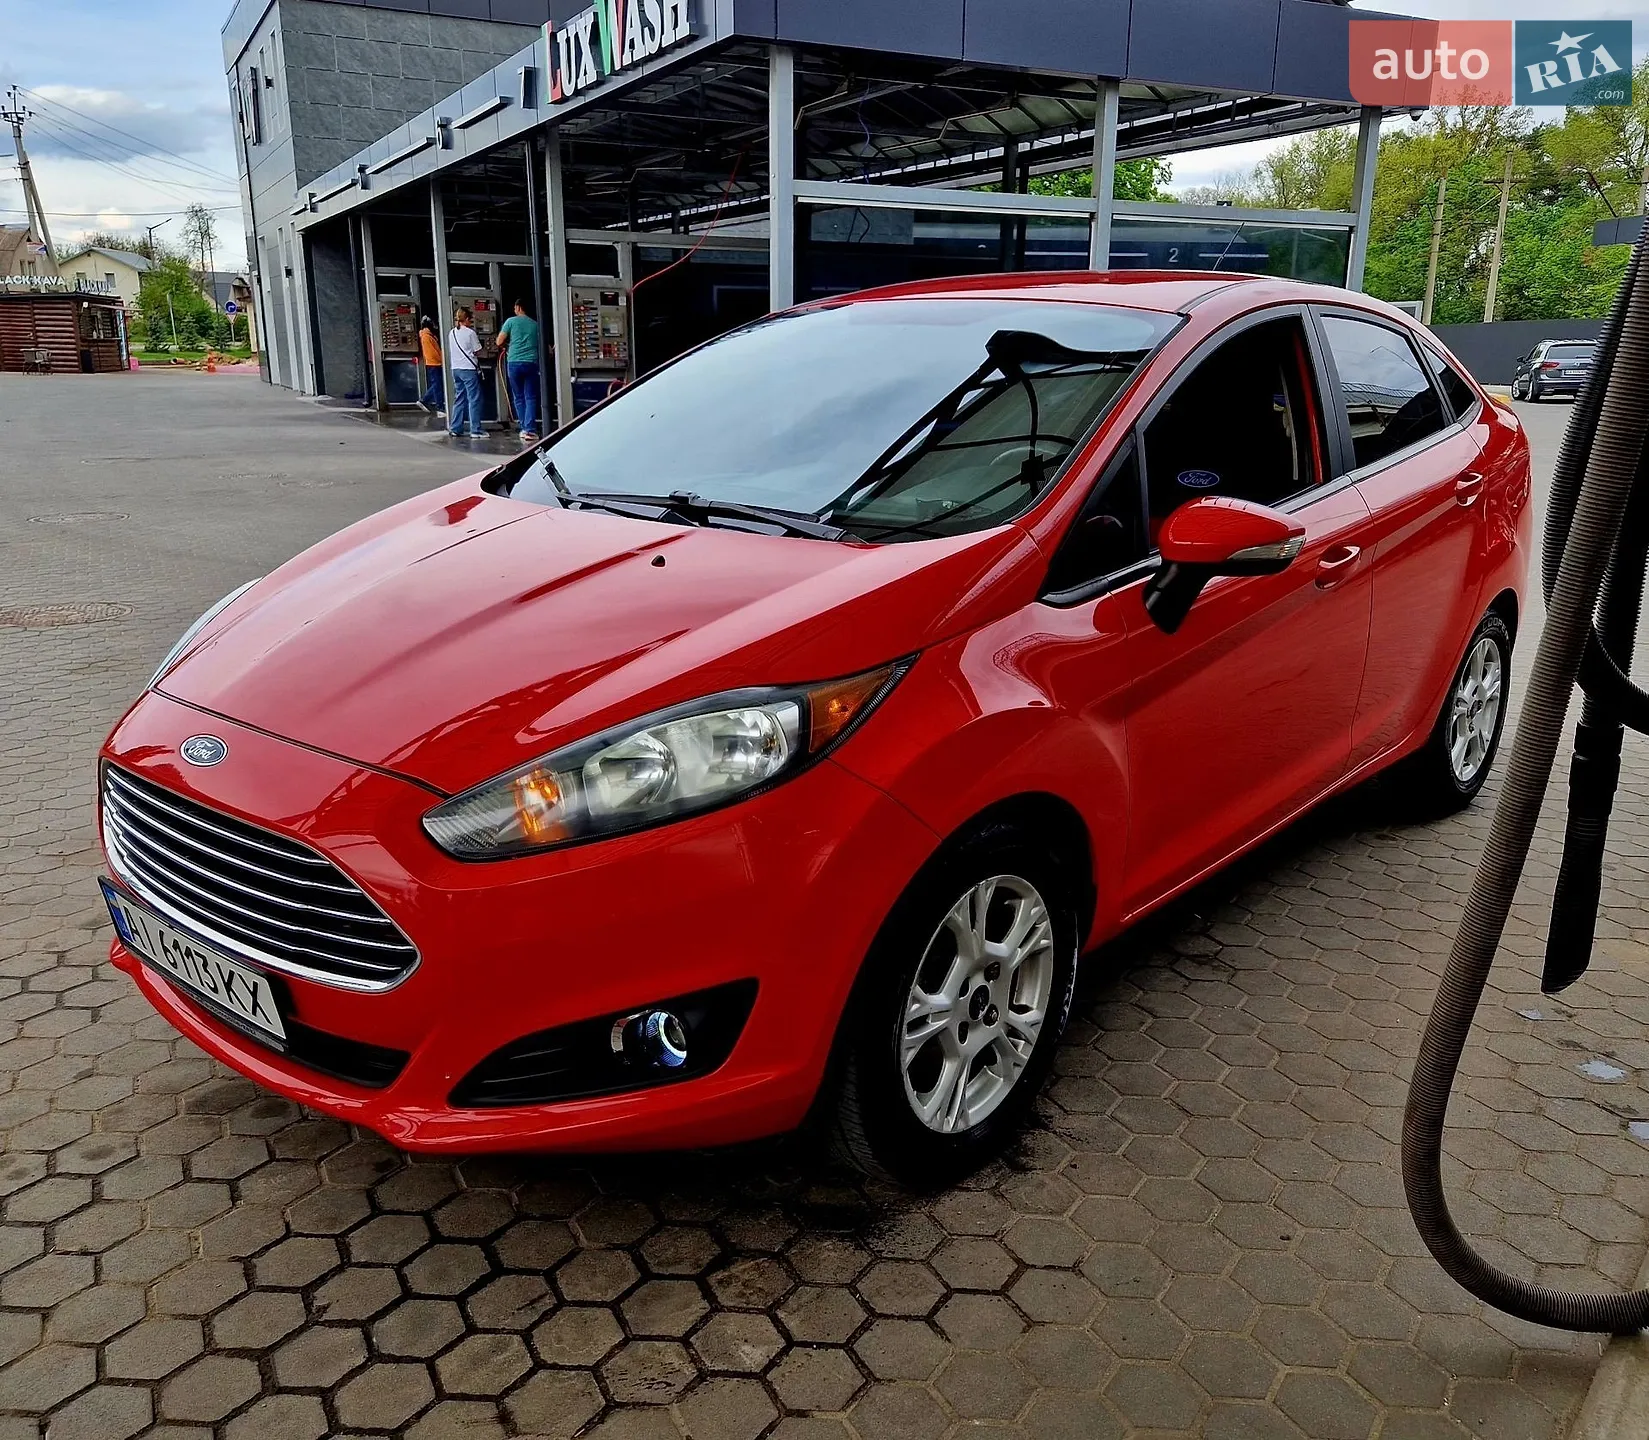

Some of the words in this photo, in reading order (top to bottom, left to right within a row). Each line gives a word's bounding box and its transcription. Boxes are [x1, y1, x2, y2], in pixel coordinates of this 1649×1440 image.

[1169, 247, 1179, 263] 2
[1184, 472, 1213, 486] Ford
[187, 740, 217, 760] Ford
